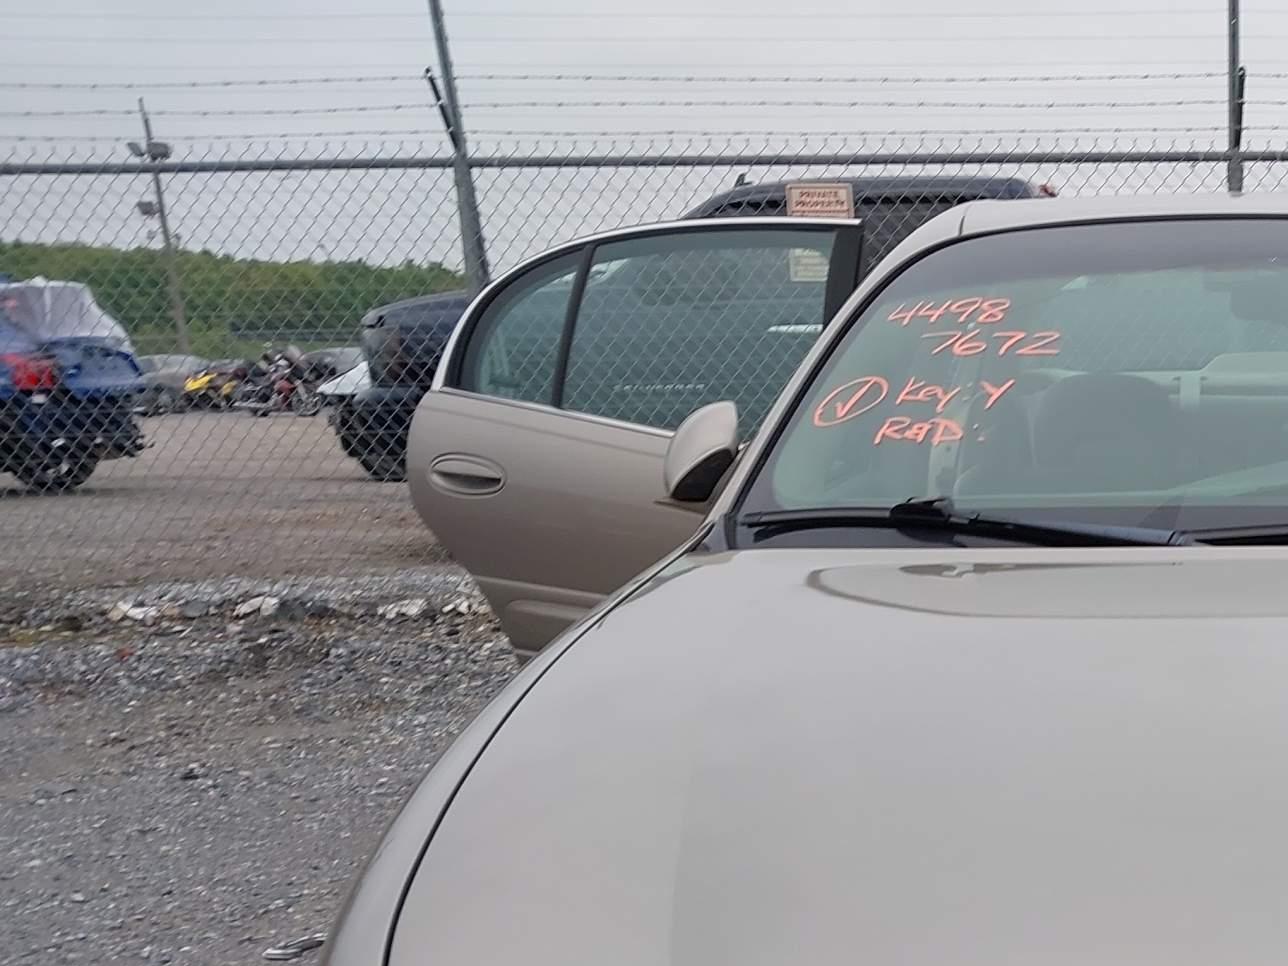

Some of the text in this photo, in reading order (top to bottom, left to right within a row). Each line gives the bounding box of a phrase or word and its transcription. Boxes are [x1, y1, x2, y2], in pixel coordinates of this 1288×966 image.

[887, 296, 1011, 326] 4498
[920, 329, 1062, 357] 7672
[979, 378, 1016, 410] Y
